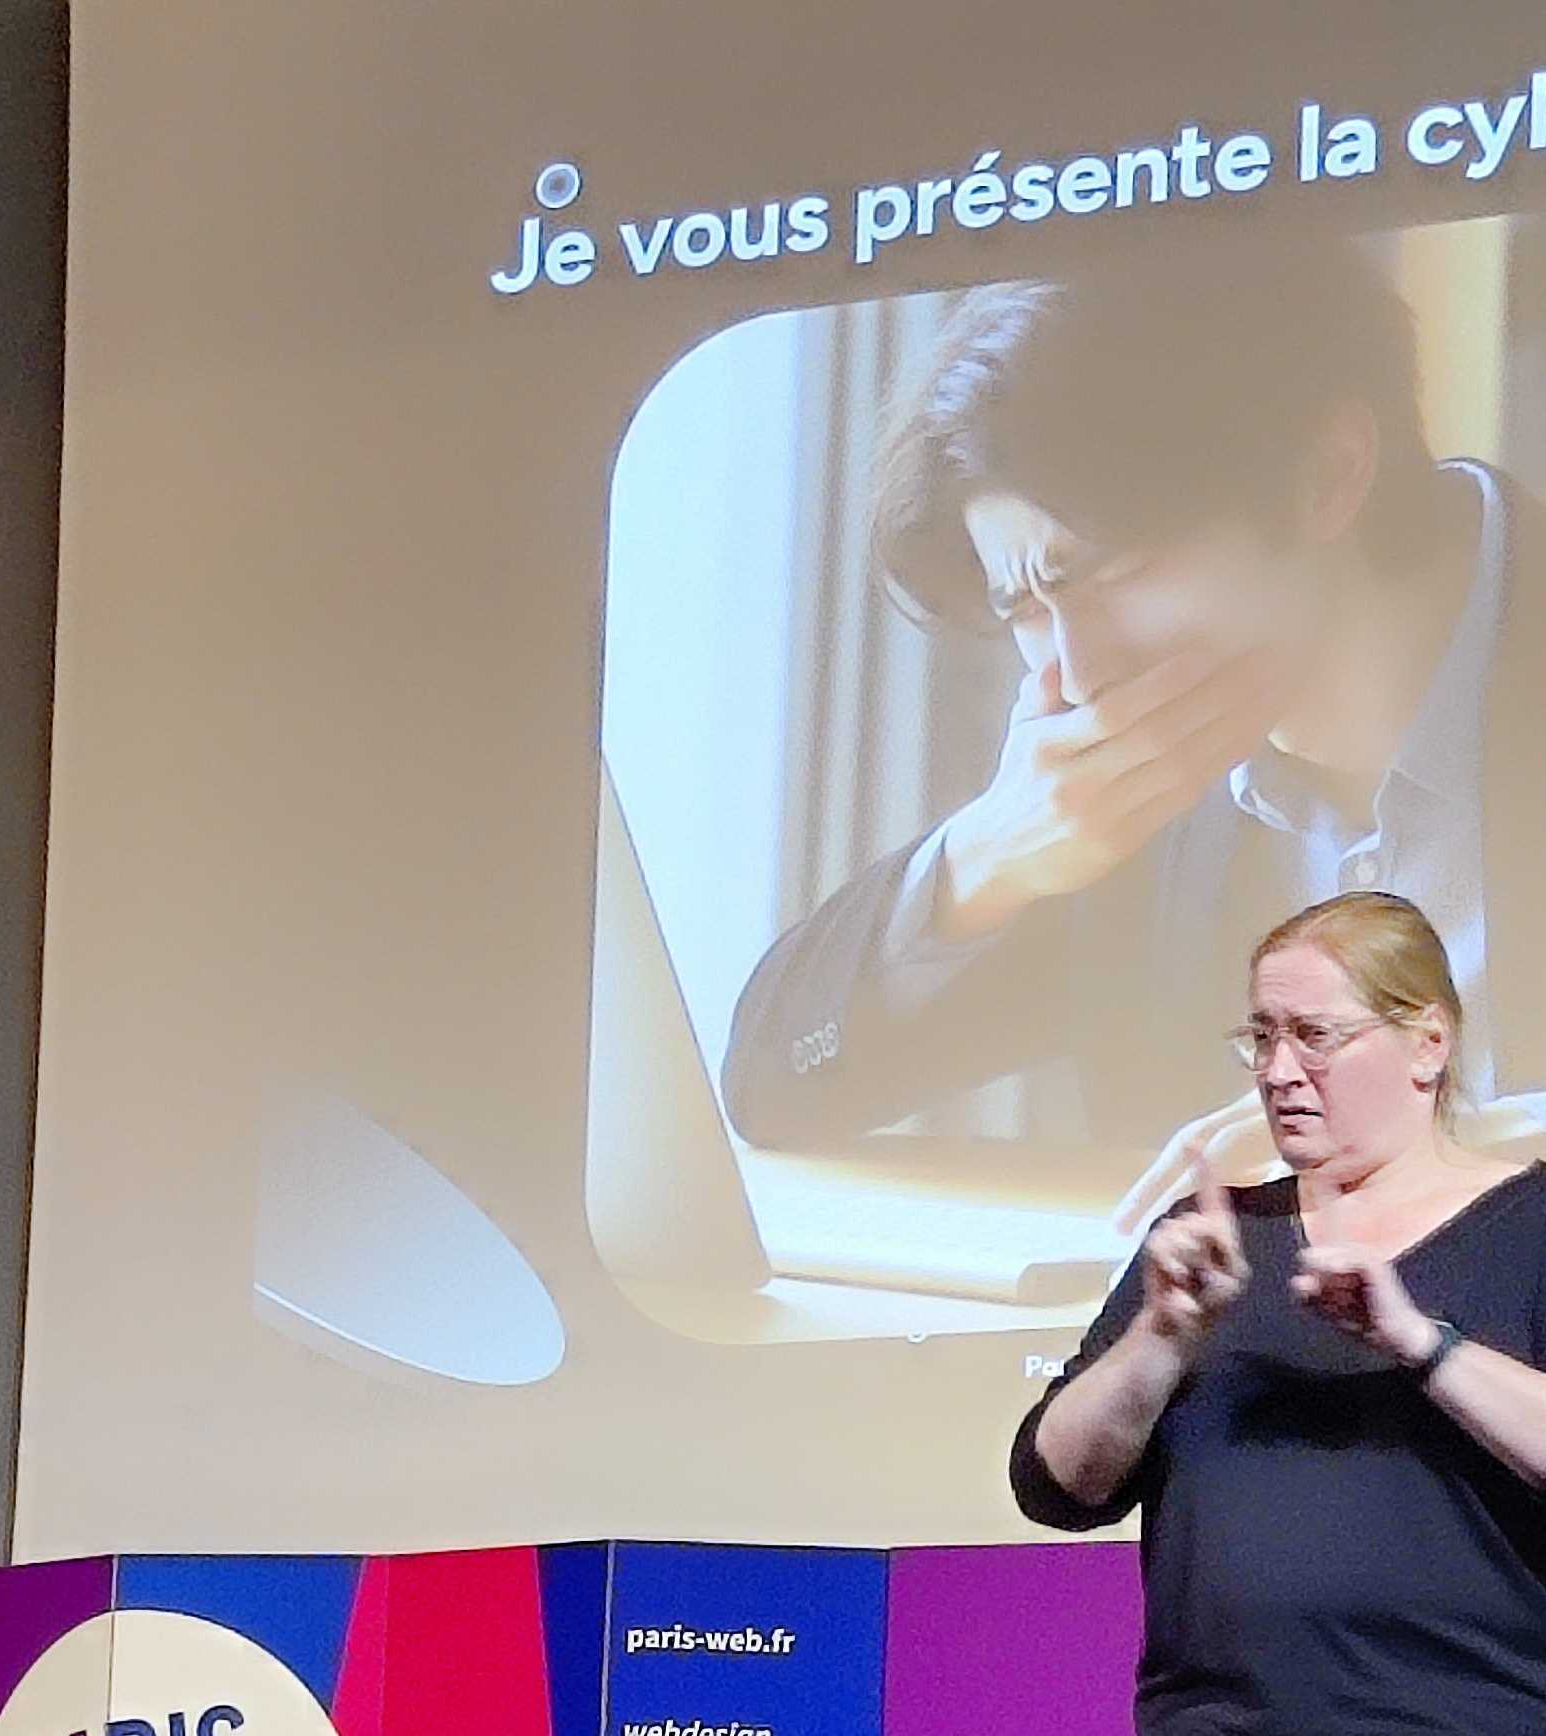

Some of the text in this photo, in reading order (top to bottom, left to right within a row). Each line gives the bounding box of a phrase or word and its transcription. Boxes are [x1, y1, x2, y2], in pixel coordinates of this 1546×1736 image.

[490, 218, 596, 294] Je
[620, 197, 829, 274] vous
[856, 125, 1270, 262] présente
[1300, 105, 1376, 180] la
[626, 1625, 794, 1653] paris-web.fr
